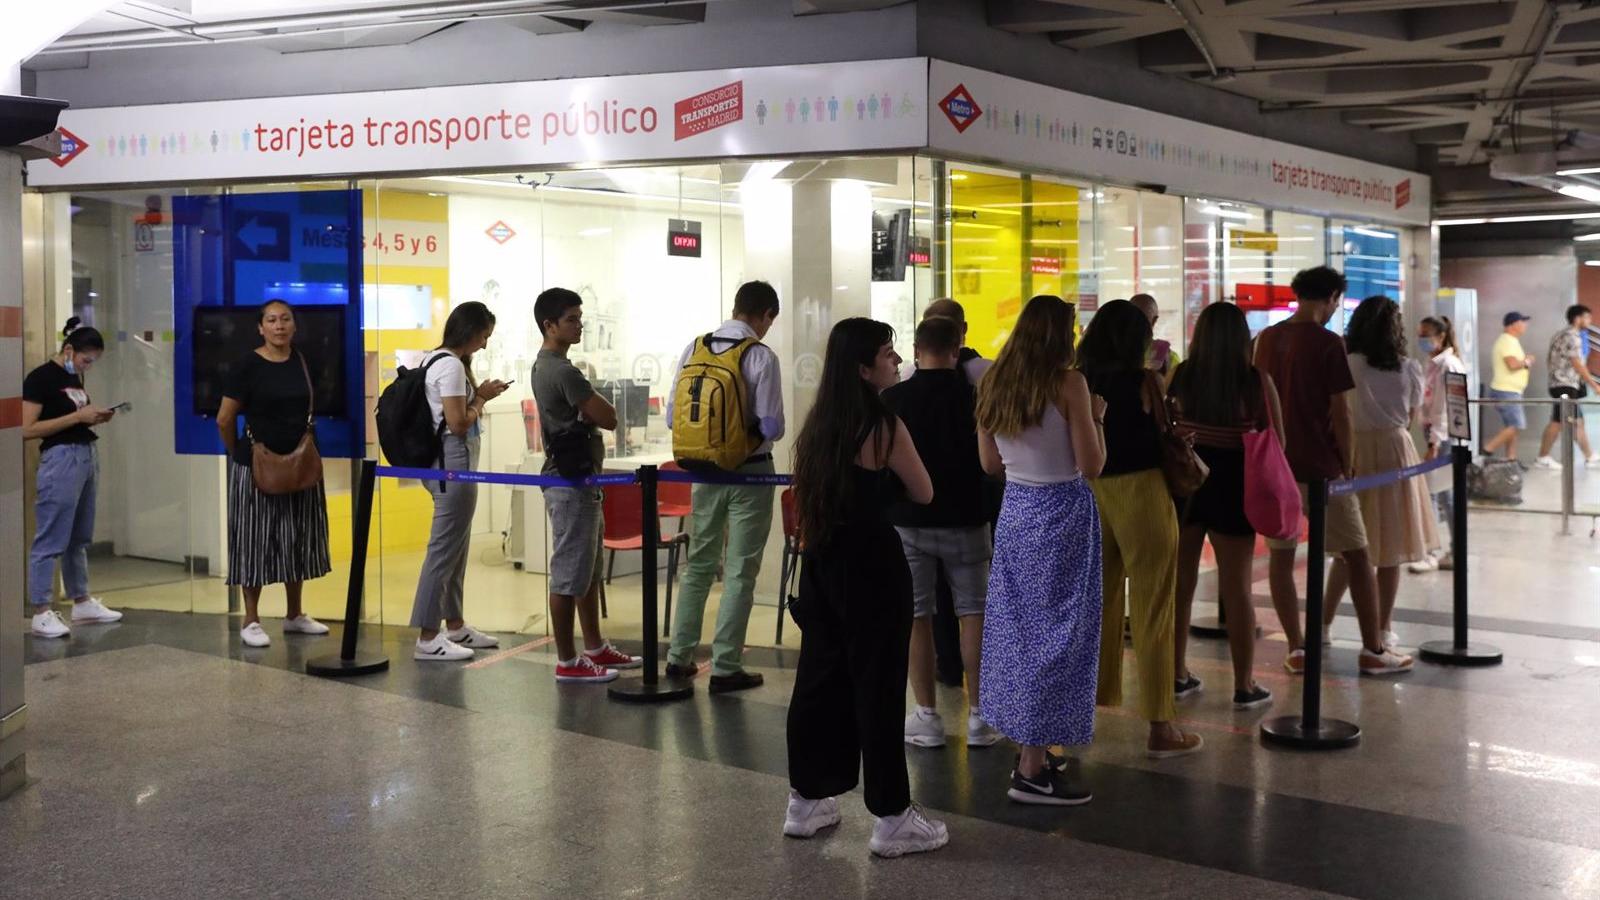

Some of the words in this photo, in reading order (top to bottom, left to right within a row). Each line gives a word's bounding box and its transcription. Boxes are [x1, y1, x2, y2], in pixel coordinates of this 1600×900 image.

[692, 85, 739, 108] CONSORCIO
[951, 101, 971, 115] Metro
[681, 97, 739, 124] TRANSPORTES
[707, 109, 739, 128] MADRID
[254, 118, 354, 157] tarjeta
[364, 109, 531, 150] transporte
[543, 100, 658, 145] público
[1272, 160, 1308, 190] tarjeta
[1311, 169, 1361, 197] transporte
[1363, 179, 1392, 203] público
[372, 232, 389, 254] 4,
[394, 233, 405, 252] 5
[411, 238, 421, 255] y
[426, 235, 437, 252] 6
